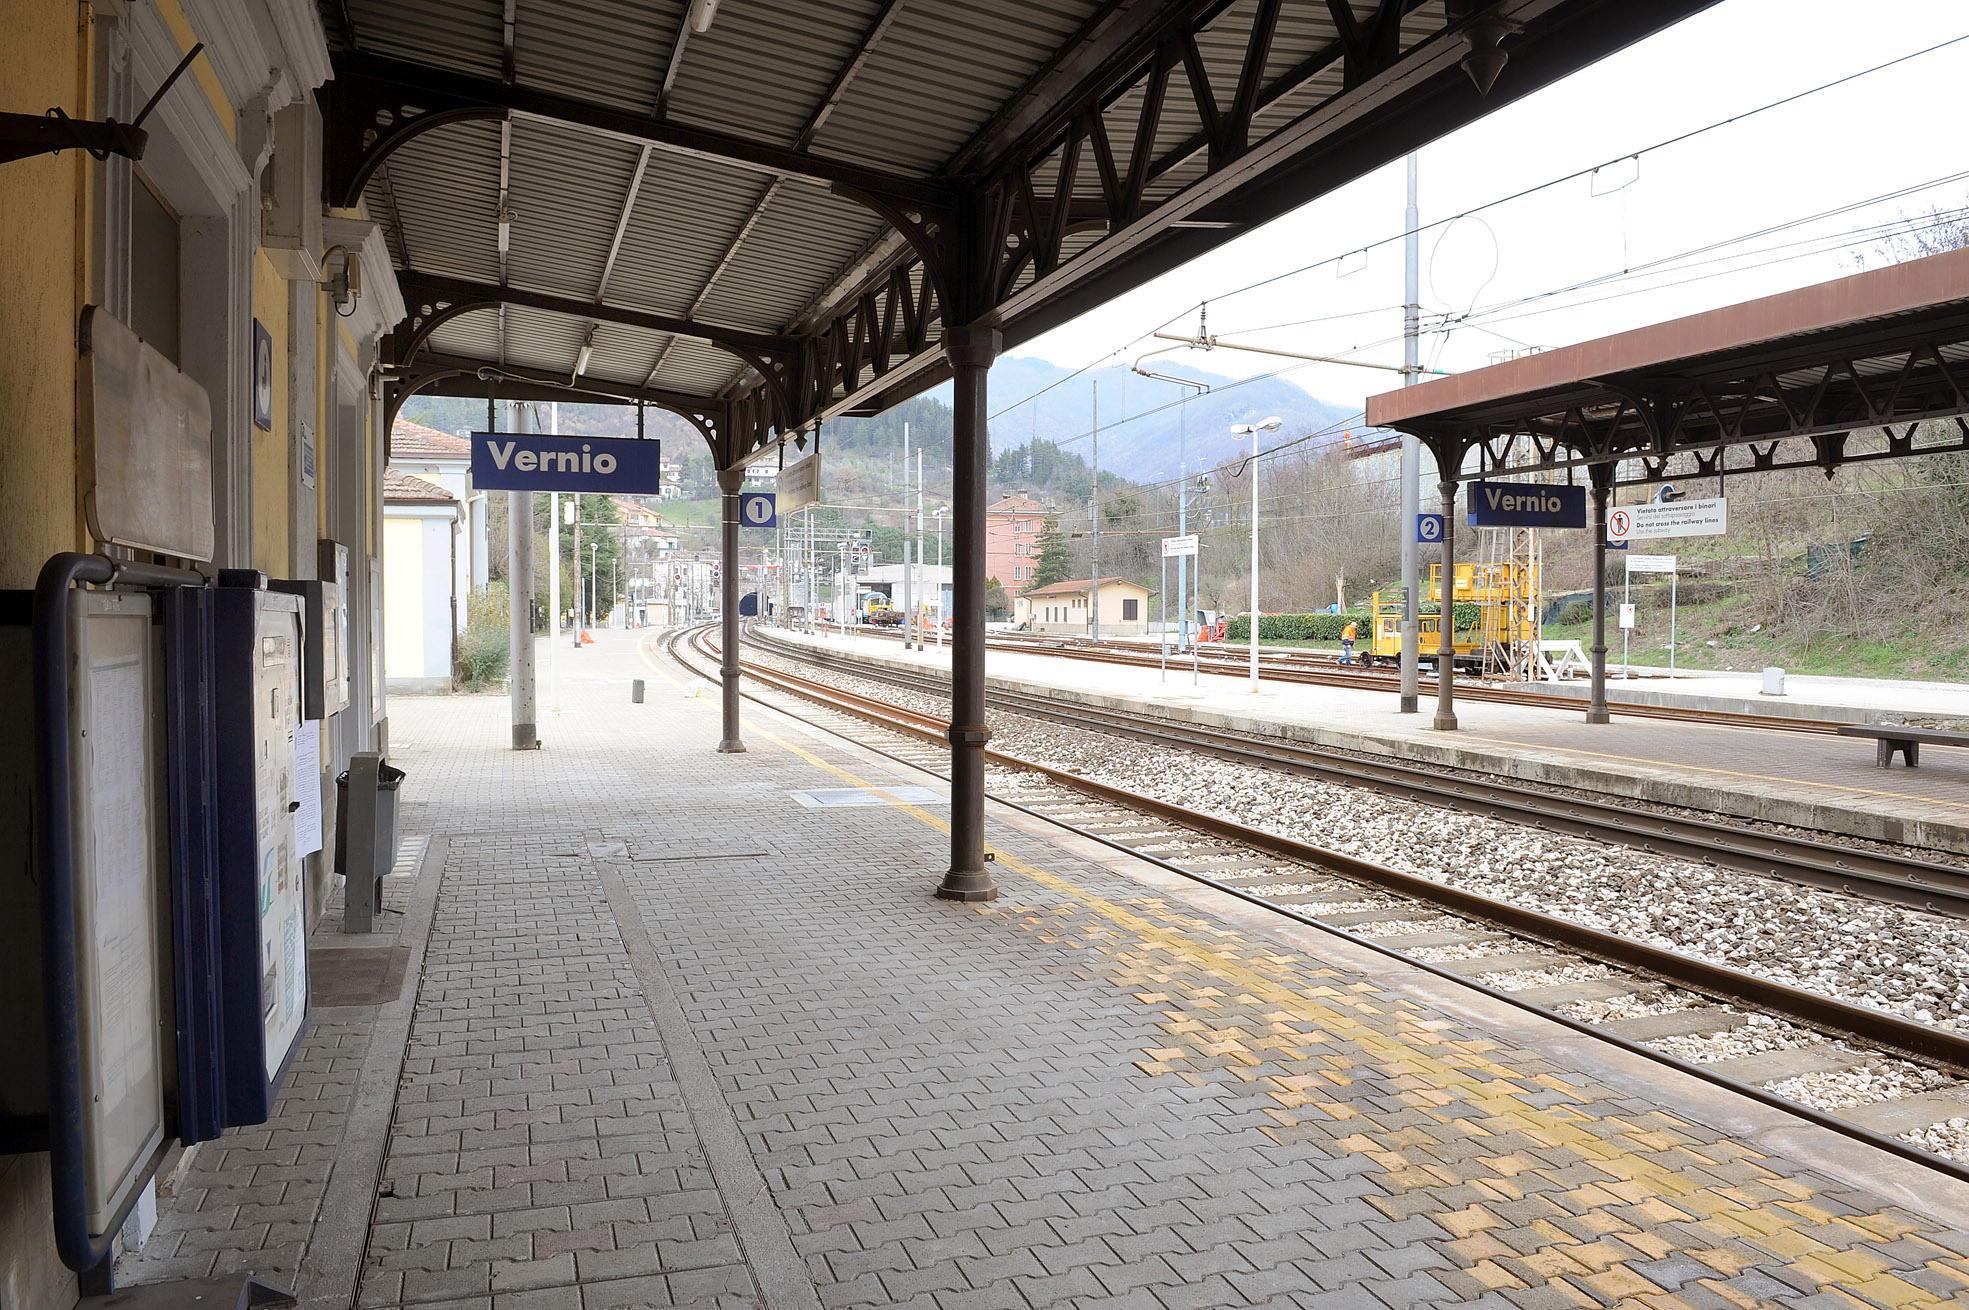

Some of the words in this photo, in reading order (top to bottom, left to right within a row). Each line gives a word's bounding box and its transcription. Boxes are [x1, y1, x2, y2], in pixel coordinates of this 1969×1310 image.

[486, 441, 617, 474] Vernio
[1484, 487, 1562, 513] Vernio
[755, 501, 763, 519] 1
[1658, 505, 1694, 513] attraversare
[1425, 520, 1435, 536] 2
[1681, 518, 1703, 526] railway
